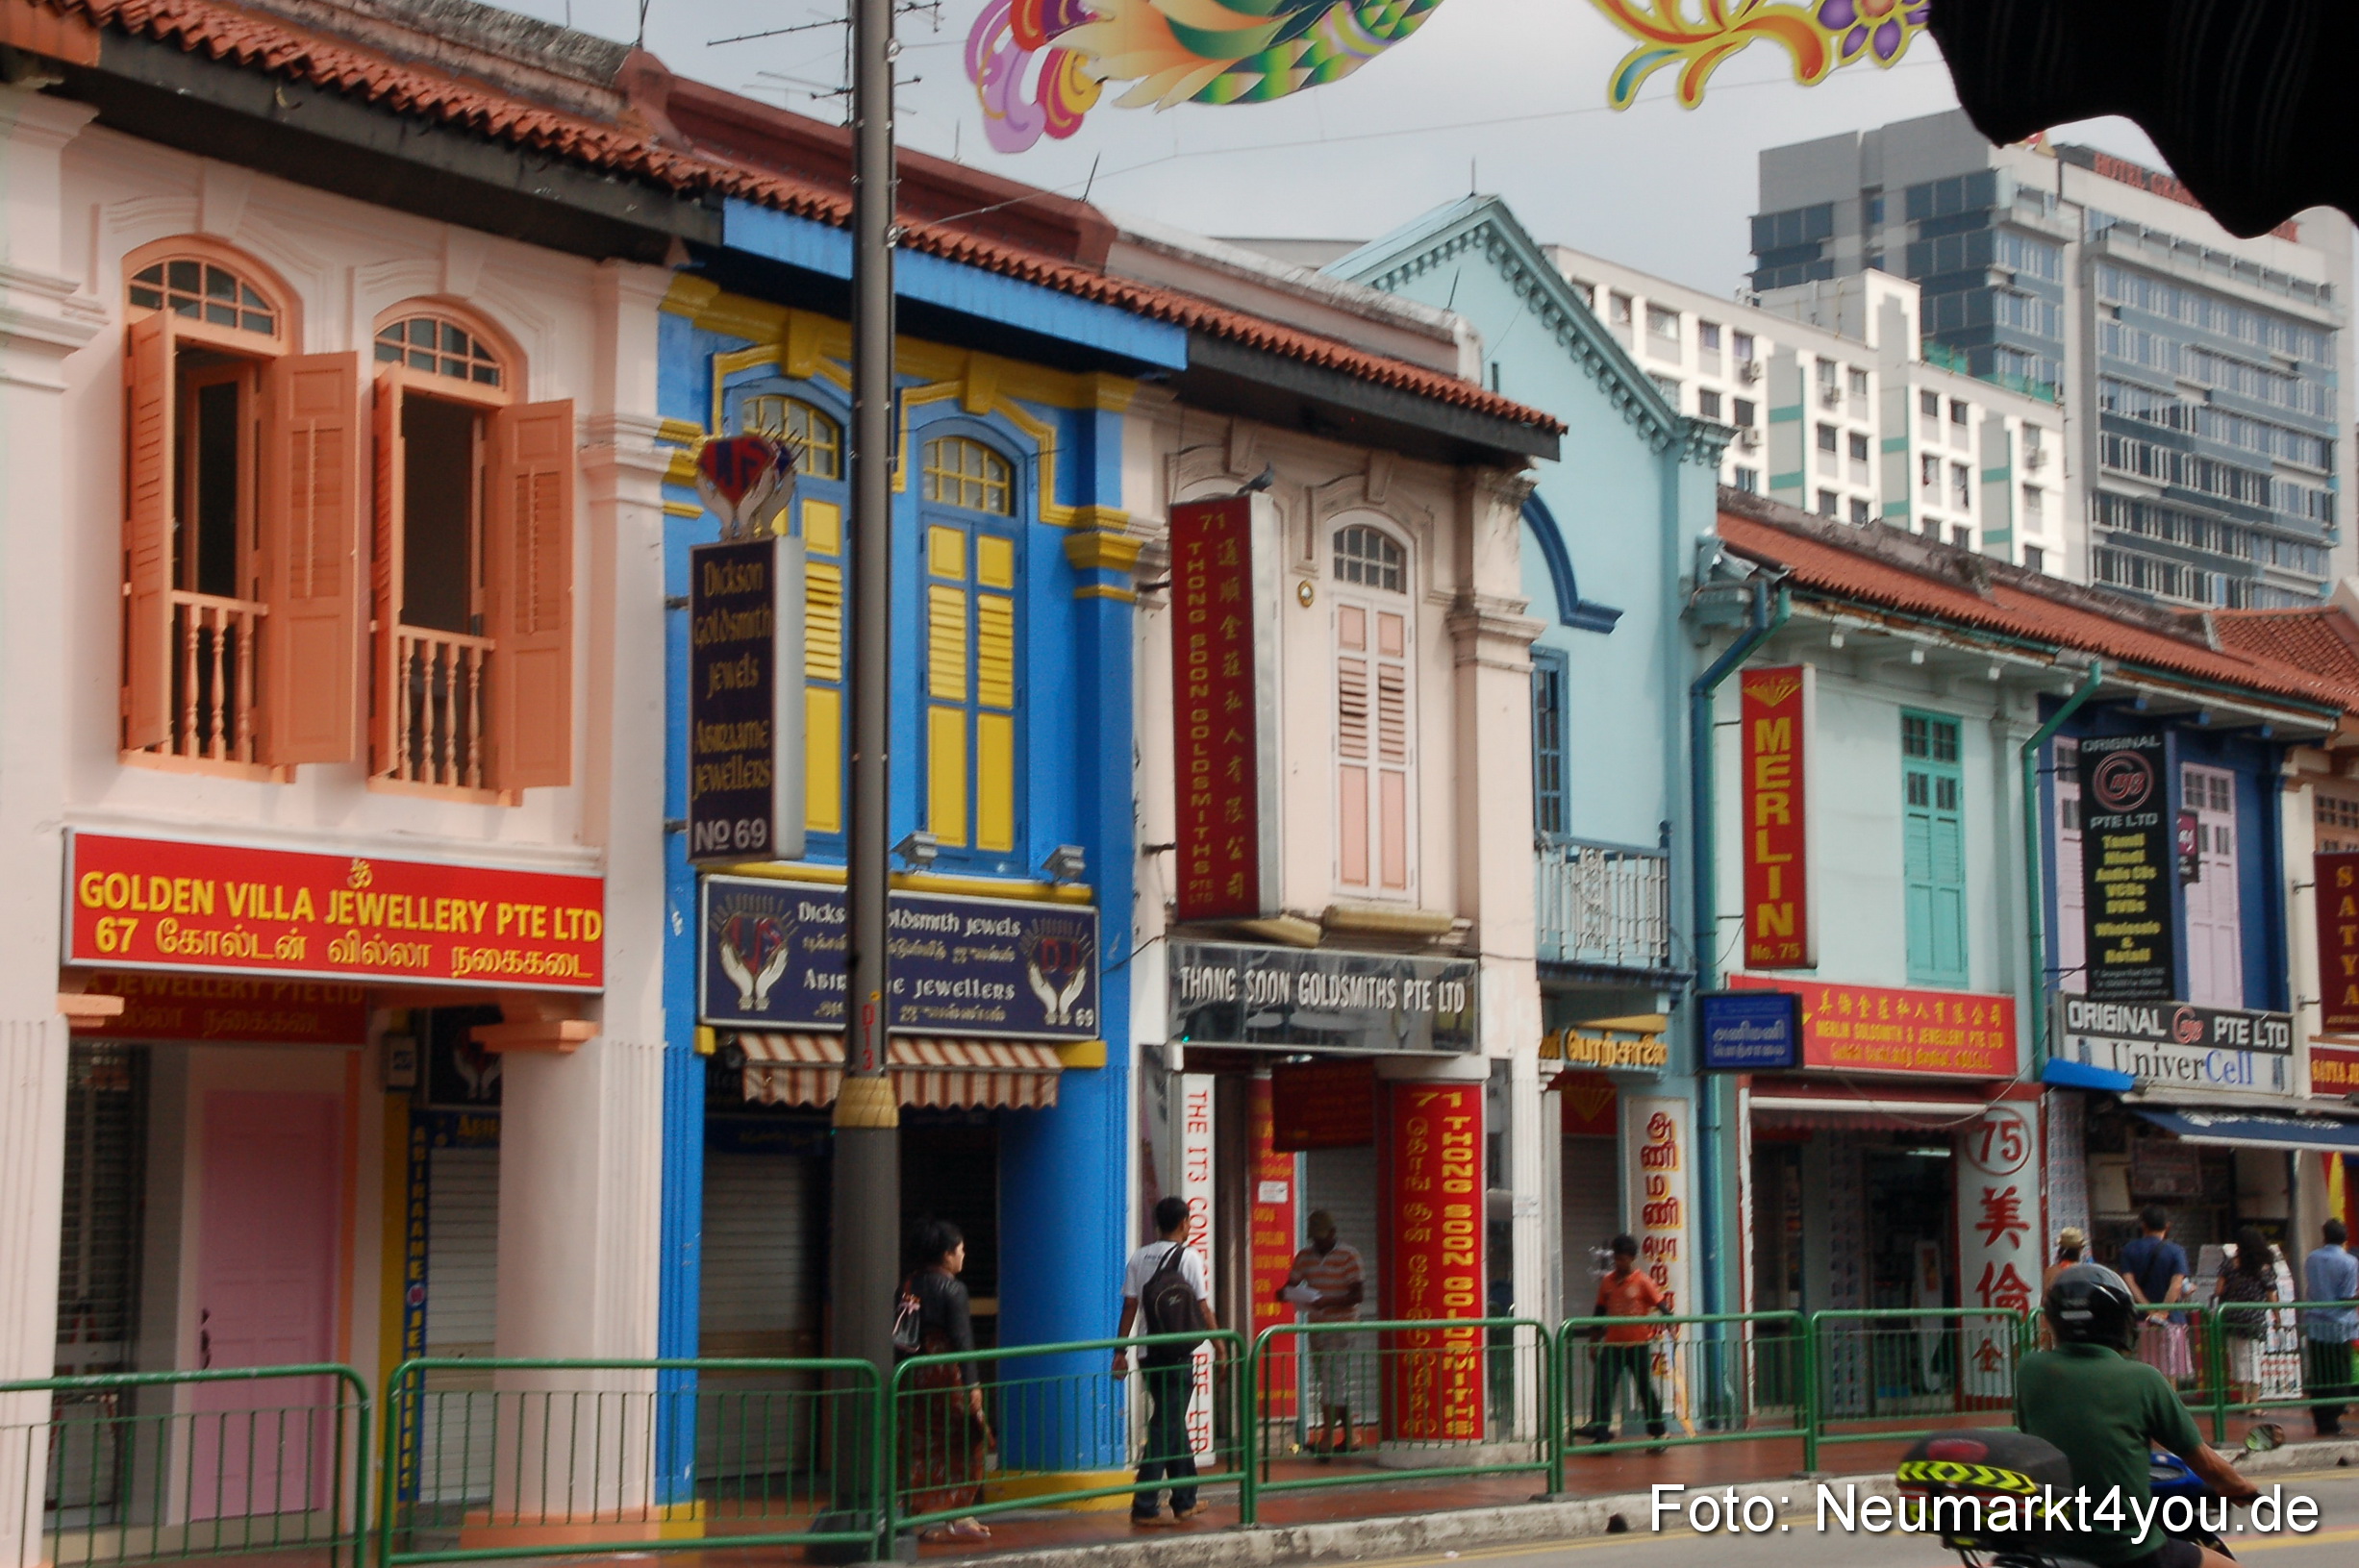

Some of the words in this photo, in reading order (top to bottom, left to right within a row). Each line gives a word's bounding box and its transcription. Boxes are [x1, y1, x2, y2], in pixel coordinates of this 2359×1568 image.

[1200, 512, 1226, 531] 71
[1187, 542, 1208, 624] THONG
[1189, 634, 1210, 698] SOON
[2081, 734, 2162, 753] ORIGINAL
[1190, 709, 1212, 874] GOLDSMITHS
[734, 817, 767, 849] 69
[1754, 716, 1794, 939] MERLIN
[2090, 814, 2123, 830] PTE
[2125, 812, 2159, 828] LTD
[79, 870, 215, 916] GOLDEN
[224, 881, 316, 923] VILLA
[323, 888, 489, 934] JEWELLERY
[495, 903, 546, 939] PTE
[552, 906, 603, 943] LTD
[797, 901, 846, 924] Dicks
[94, 915, 139, 954] 67
[1750, 943, 1775, 960] No.
[1779, 942, 1801, 959] 75
[1180, 966, 1238, 1003] THONG
[1245, 969, 1291, 1006] SOON
[1298, 972, 1396, 1009] GOLDSMITHS
[1403, 979, 1433, 1012] PTE
[1438, 981, 1467, 1014] LTD
[1075, 1008, 1094, 1028] 69
[2068, 1000, 2167, 1036] ORIGINAL
[2213, 1014, 2250, 1046] PTE
[2253, 1019, 2290, 1049] LTD
[2110, 1041, 2255, 1086] UniverCell
[1188, 1090, 1208, 1134] THE
[1442, 1116, 1474, 1194] THONG
[1980, 1119, 2023, 1164] 75
[1443, 1204, 1474, 1266] SOON
